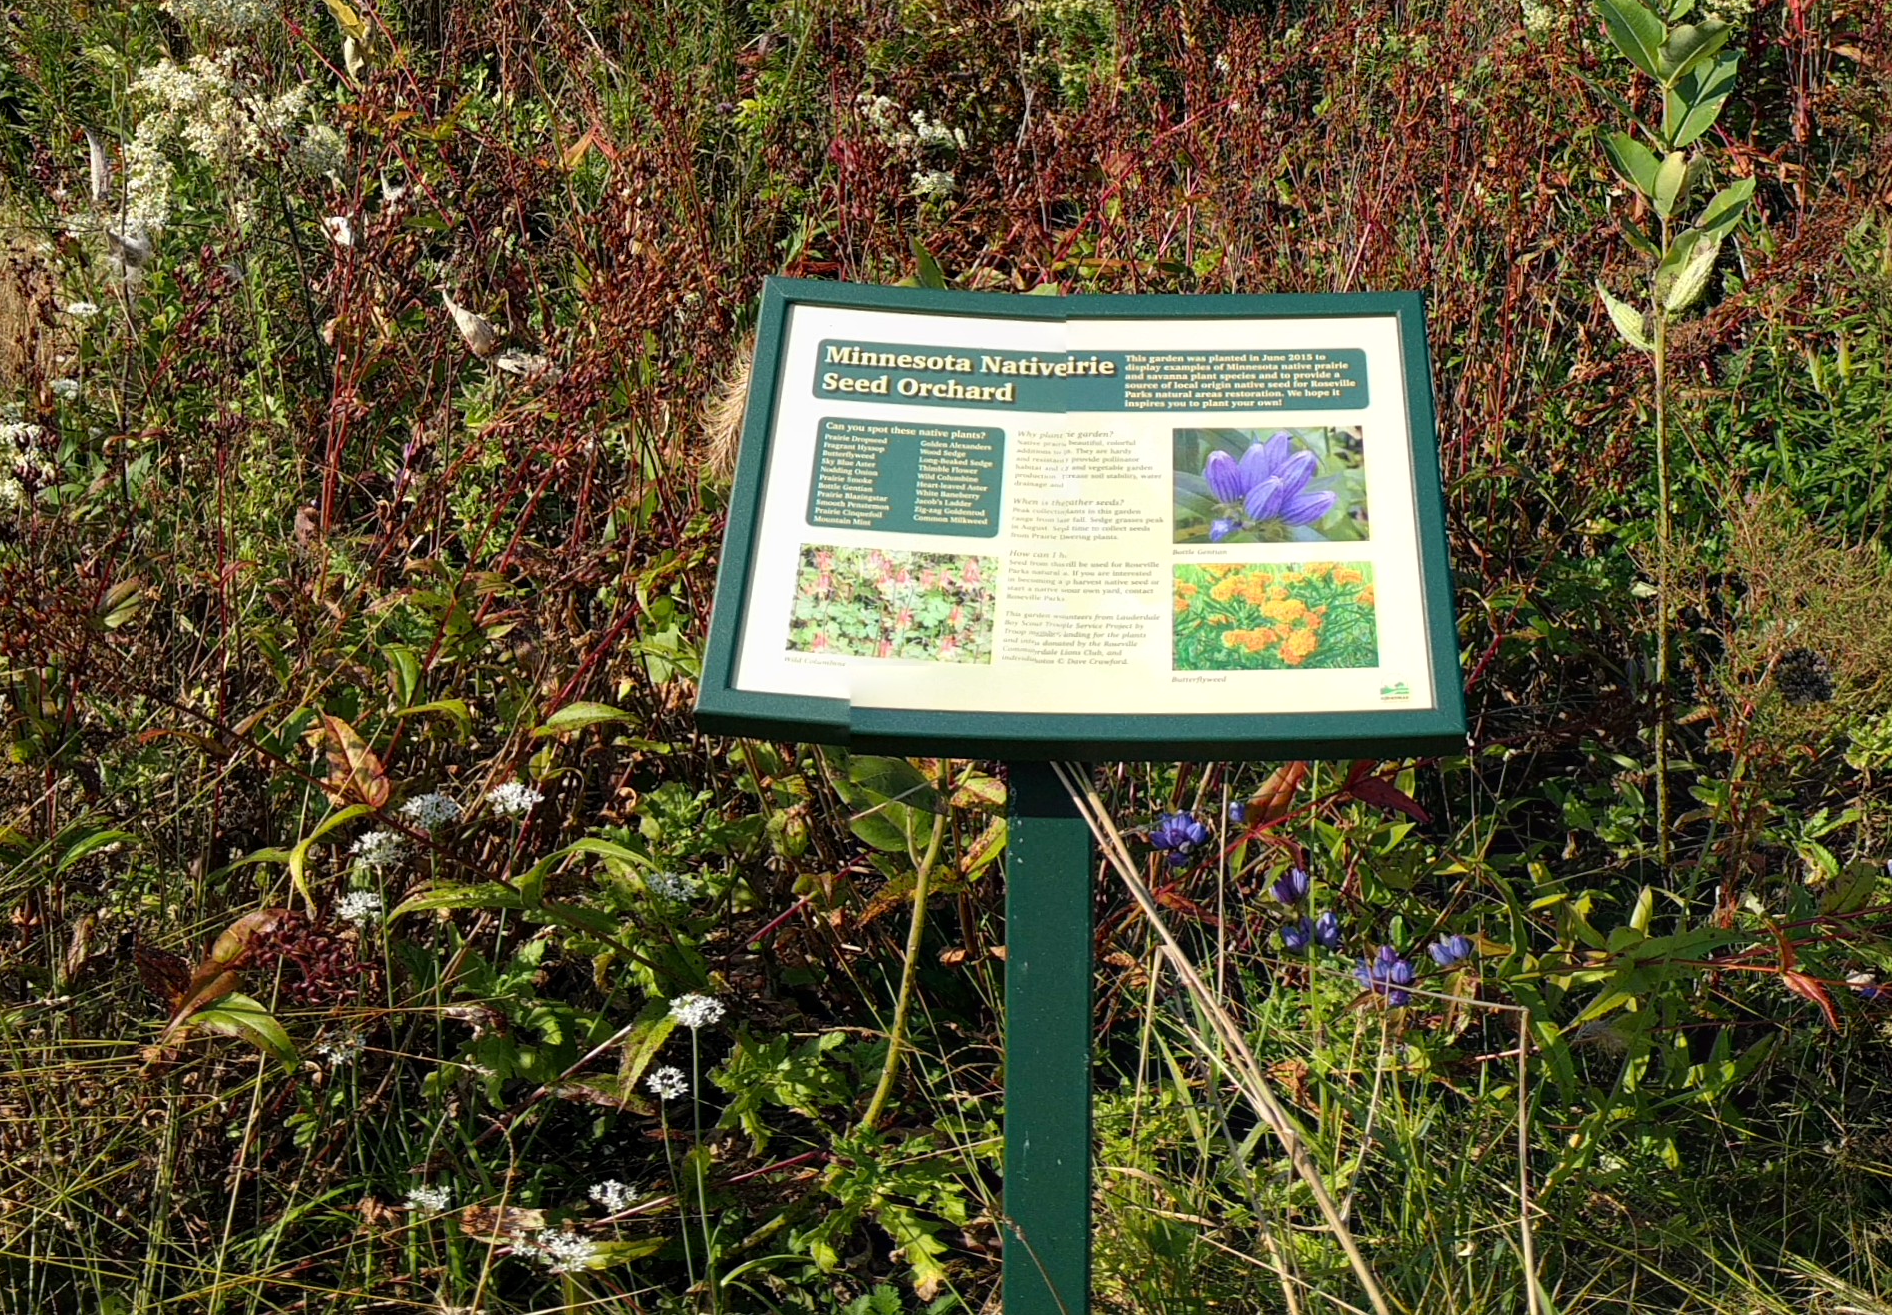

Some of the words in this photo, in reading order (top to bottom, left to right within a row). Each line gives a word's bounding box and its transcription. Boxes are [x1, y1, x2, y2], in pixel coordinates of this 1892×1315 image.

[825, 346, 971, 372] Minnesota
[1149, 354, 1183, 364] garden
[1209, 354, 1246, 363] planted
[1262, 353, 1285, 361] June
[1288, 353, 1312, 361] 2015
[1125, 364, 1161, 373] display
[1164, 363, 1210, 373] examples
[1227, 362, 1278, 370] Minnesota
[1282, 362, 1311, 370] native
[1315, 362, 1348, 372] prairie
[1125, 372, 1143, 380] and
[1191, 372, 1216, 381] plant
[1220, 371, 1256, 381] species
[1259, 371, 1277, 379] and
[1294, 370, 1330, 380] provide
[822, 373, 889, 394] Seed
[897, 377, 1013, 401] Orchard
[1174, 380, 1198, 388] local
[1201, 380, 1231, 390] origin
[1235, 380, 1264, 388] native
[1293, 379, 1308, 387] for
[1311, 379, 1356, 387] Roseville
[1125, 390, 1152, 398] Parks
[1225, 389, 1284, 397] restoration.
[1305, 388, 1329, 398] hope
[1332, 388, 1340, 396] it
[1125, 399, 1164, 409] inspires
[1202, 399, 1229, 408] plant
[1232, 400, 1255, 408] your
[1258, 398, 1282, 406] own!
[826, 422, 844, 430] Can
[846, 425, 865, 433] you
[867, 424, 888, 435] spot
[891, 425, 916, 434] these
[919, 427, 948, 436] native
[951, 429, 986, 440] plants?
[1078, 431, 1114, 439] garden?
[852, 435, 887, 445] Dropseed
[921, 440, 947, 448] Golden
[949, 442, 992, 450] Alexanders
[824, 442, 855, 451] Fragrant
[857, 444, 884, 453] Hyssop
[823, 450, 875, 461] Butterflyweed
[943, 450, 966, 458] Sedge
[821, 458, 835, 466] Sky
[919, 457, 967, 467] Long-Beaked
[970, 459, 993, 468] Sedge
[820, 466, 852, 475] Nodding
[854, 468, 878, 476] Onion
[820, 474, 844, 482] Prairie
[937, 474, 978, 482] Columbine
[818, 482, 840, 490] Bottle
[843, 484, 873, 492] Gentian
[916, 481, 965, 490] Heart-leaved
[845, 492, 888, 503] Blazingstar
[916, 489, 938, 497] White
[941, 491, 980, 501] Baneberry
[816, 499, 845, 507] Smooth
[848, 501, 889, 510] Penstemon
[815, 507, 840, 515] Prairie
[843, 509, 882, 519] Cinquefoil
[814, 516, 850, 524] Mountain
[913, 514, 948, 522] Common
[950, 516, 987, 524] Milkweed
